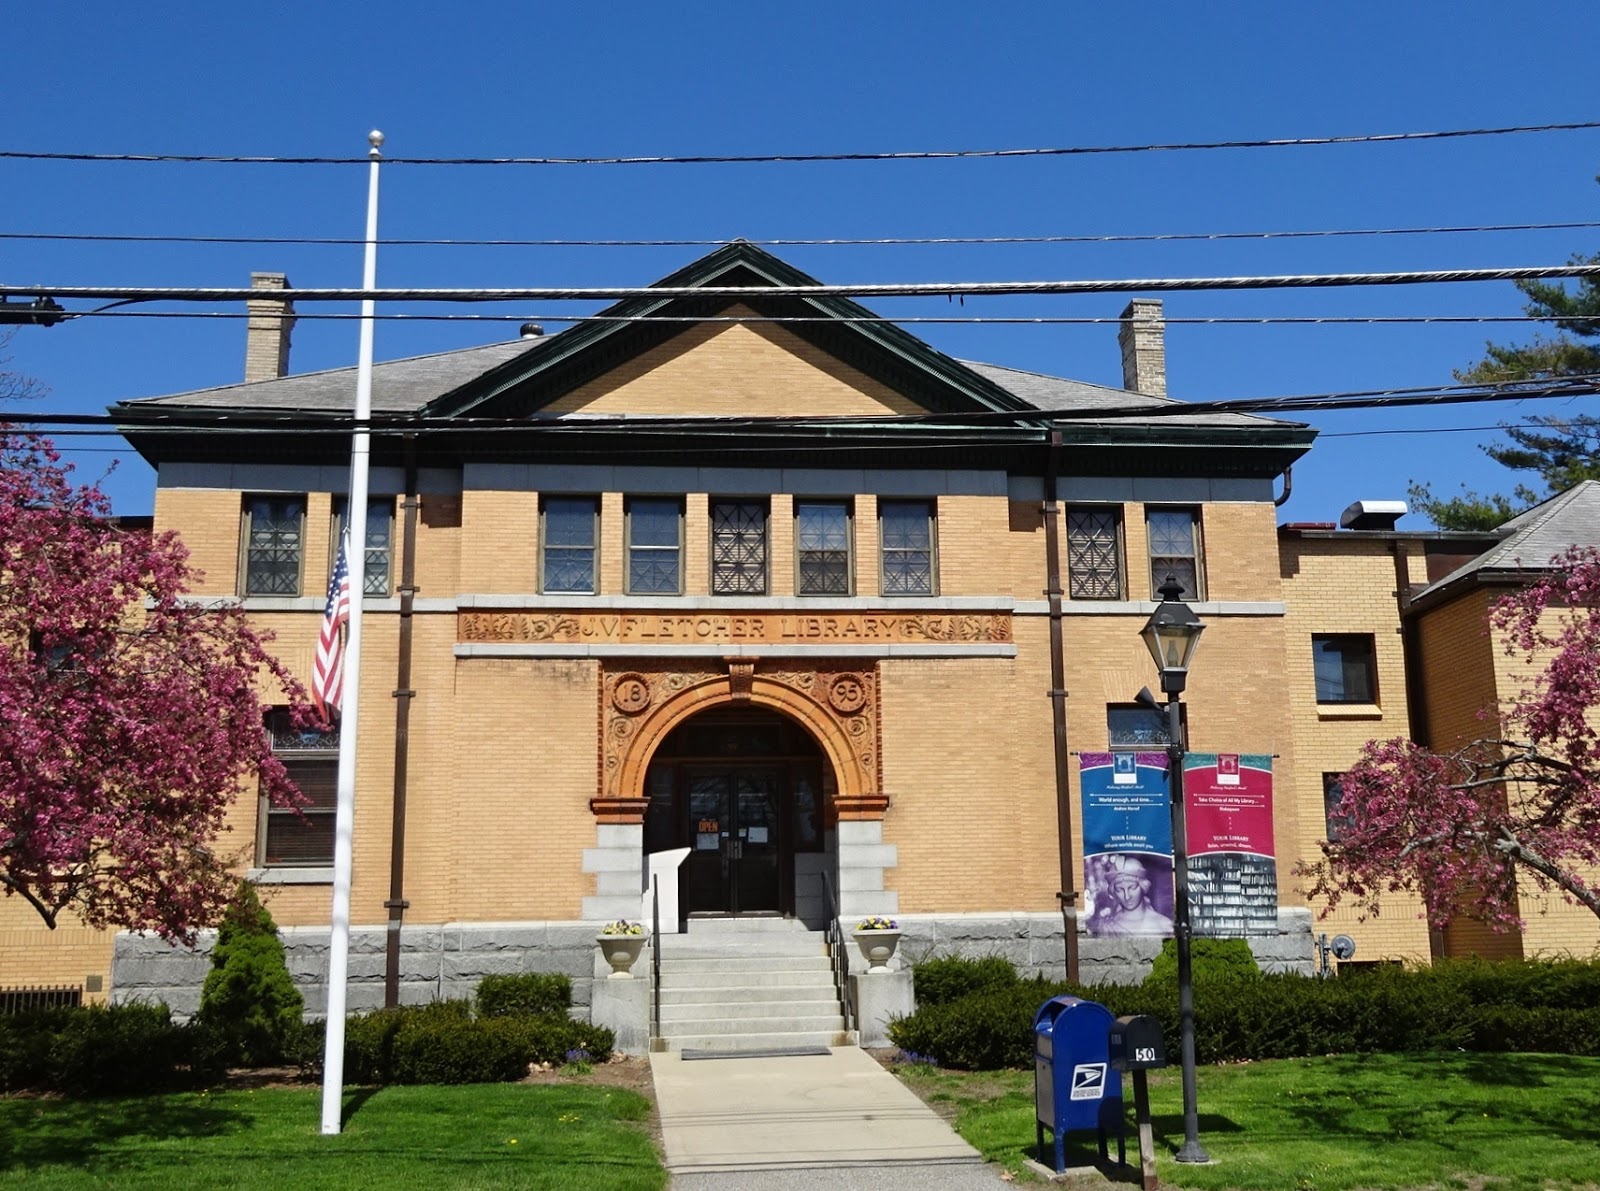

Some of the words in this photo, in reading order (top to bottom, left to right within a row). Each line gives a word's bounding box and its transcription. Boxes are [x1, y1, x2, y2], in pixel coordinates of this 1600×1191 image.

[781, 618, 897, 638] LIBRARY
[623, 684, 641, 703] 18
[836, 684, 858, 703] 95
[699, 821, 719, 832] OPEN
[1136, 1048, 1154, 1061] 50
